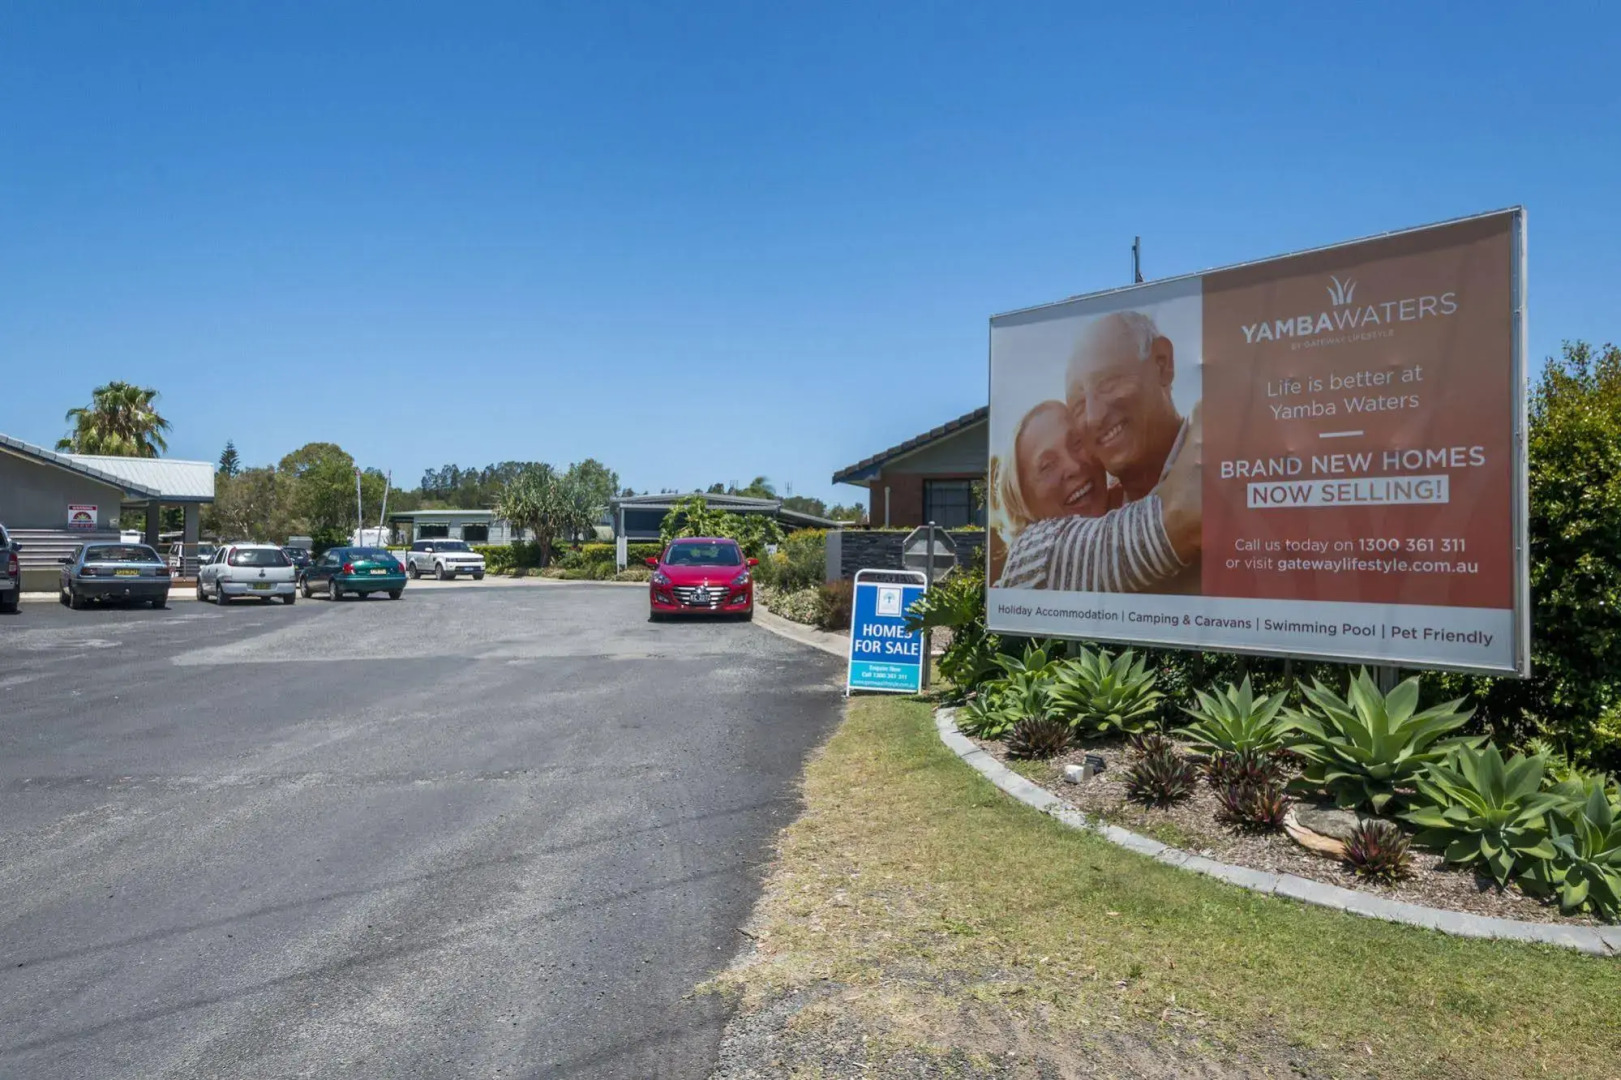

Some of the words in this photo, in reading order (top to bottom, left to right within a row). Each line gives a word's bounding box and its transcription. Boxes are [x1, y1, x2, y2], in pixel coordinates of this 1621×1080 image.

[1241, 292, 1458, 344] YAMBAWATERS
[1267, 377, 1302, 397] Life
[1309, 375, 1323, 392] is
[1330, 370, 1394, 391] better
[1401, 364, 1423, 382] at
[1269, 400, 1337, 421] Yamba
[1343, 393, 1420, 414] Waters
[1220, 457, 1303, 479] BRAND
[1311, 452, 1373, 474] NEW
[1382, 446, 1486, 471] HOMES
[1252, 484, 1312, 504] NOW
[1321, 479, 1442, 503] SELLING!
[1234, 538, 1261, 552] Call
[1265, 541, 1281, 552] us
[1285, 538, 1329, 554] today
[1333, 541, 1354, 551] on
[1358, 538, 1400, 552] 1300
[1406, 538, 1435, 552] 361
[1441, 538, 1466, 552] 311
[1225, 558, 1241, 569] or
[1244, 557, 1273, 570] visit
[1277, 557, 1479, 574] gatewaylifestyle.com.au
[998, 604, 1033, 616] Holiday
[1035, 606, 1118, 621] Accommodation
[1128, 611, 1179, 627] Camping
[1182, 615, 1191, 626] &
[1195, 615, 1252, 629] Caravans
[1264, 618, 1337, 637] Swimming
[1342, 623, 1376, 637] Pool
[1391, 626, 1418, 640] Pet
[1423, 628, 1493, 647] Friendly
[855, 639, 881, 654] FOR
[885, 641, 919, 655] SALE
